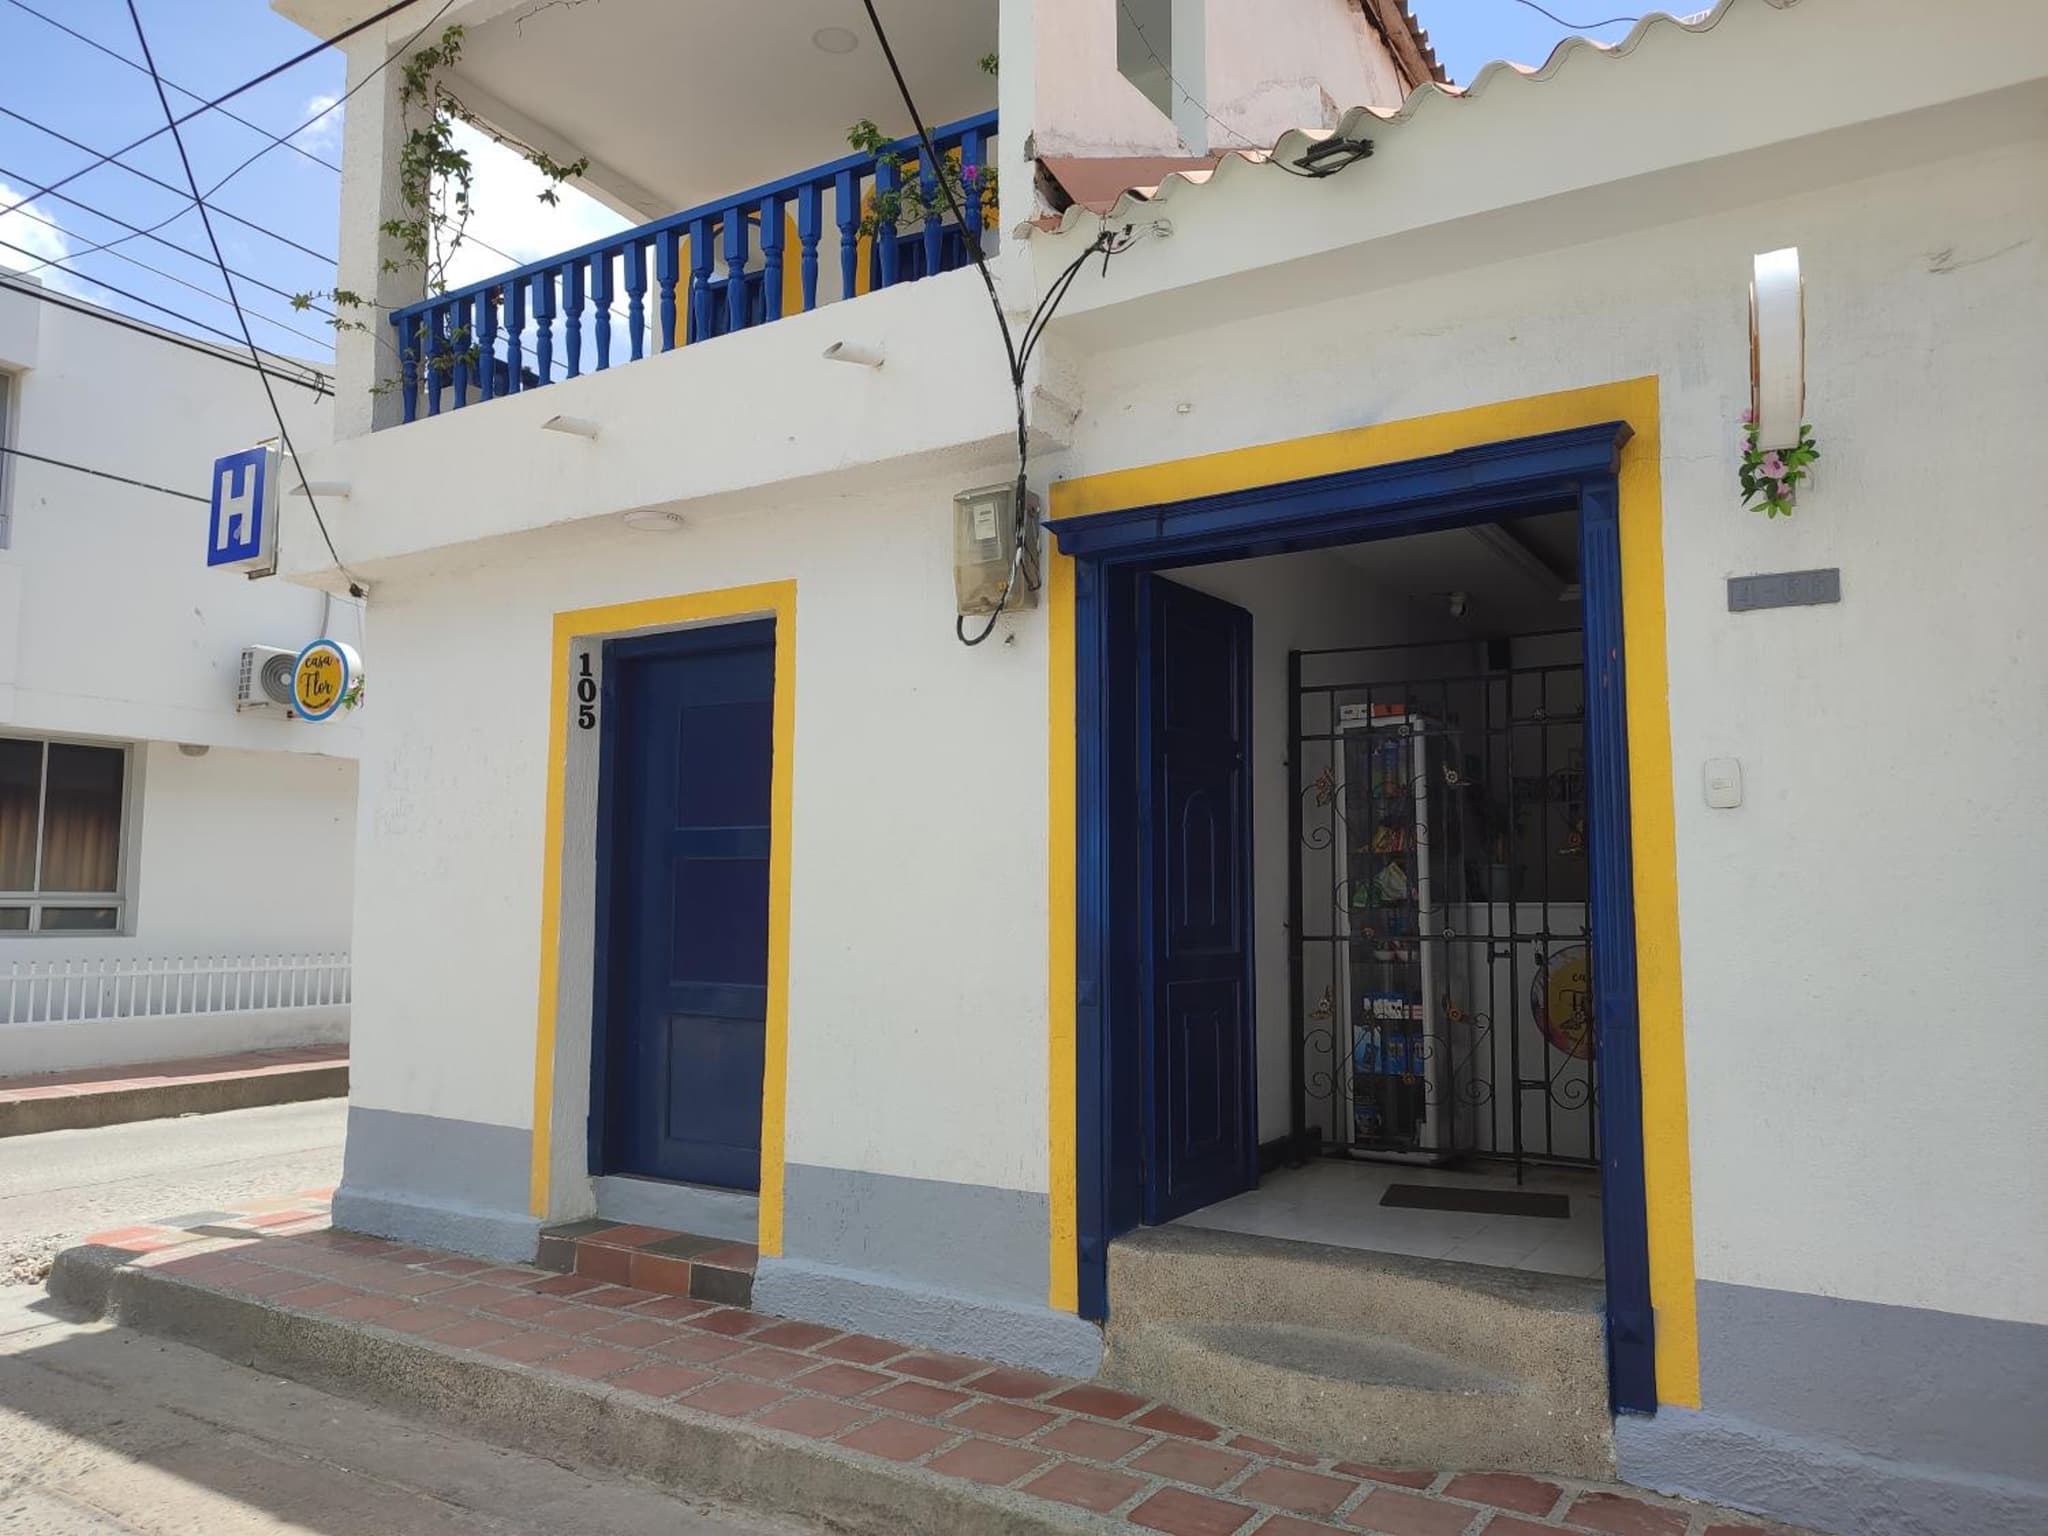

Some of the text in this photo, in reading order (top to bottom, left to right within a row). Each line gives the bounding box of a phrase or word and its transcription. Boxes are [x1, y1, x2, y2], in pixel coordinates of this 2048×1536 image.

[216, 463, 256, 551] H
[301, 670, 332, 698] Flor
[305, 655, 332, 669] casa
[577, 652, 597, 730] 105
